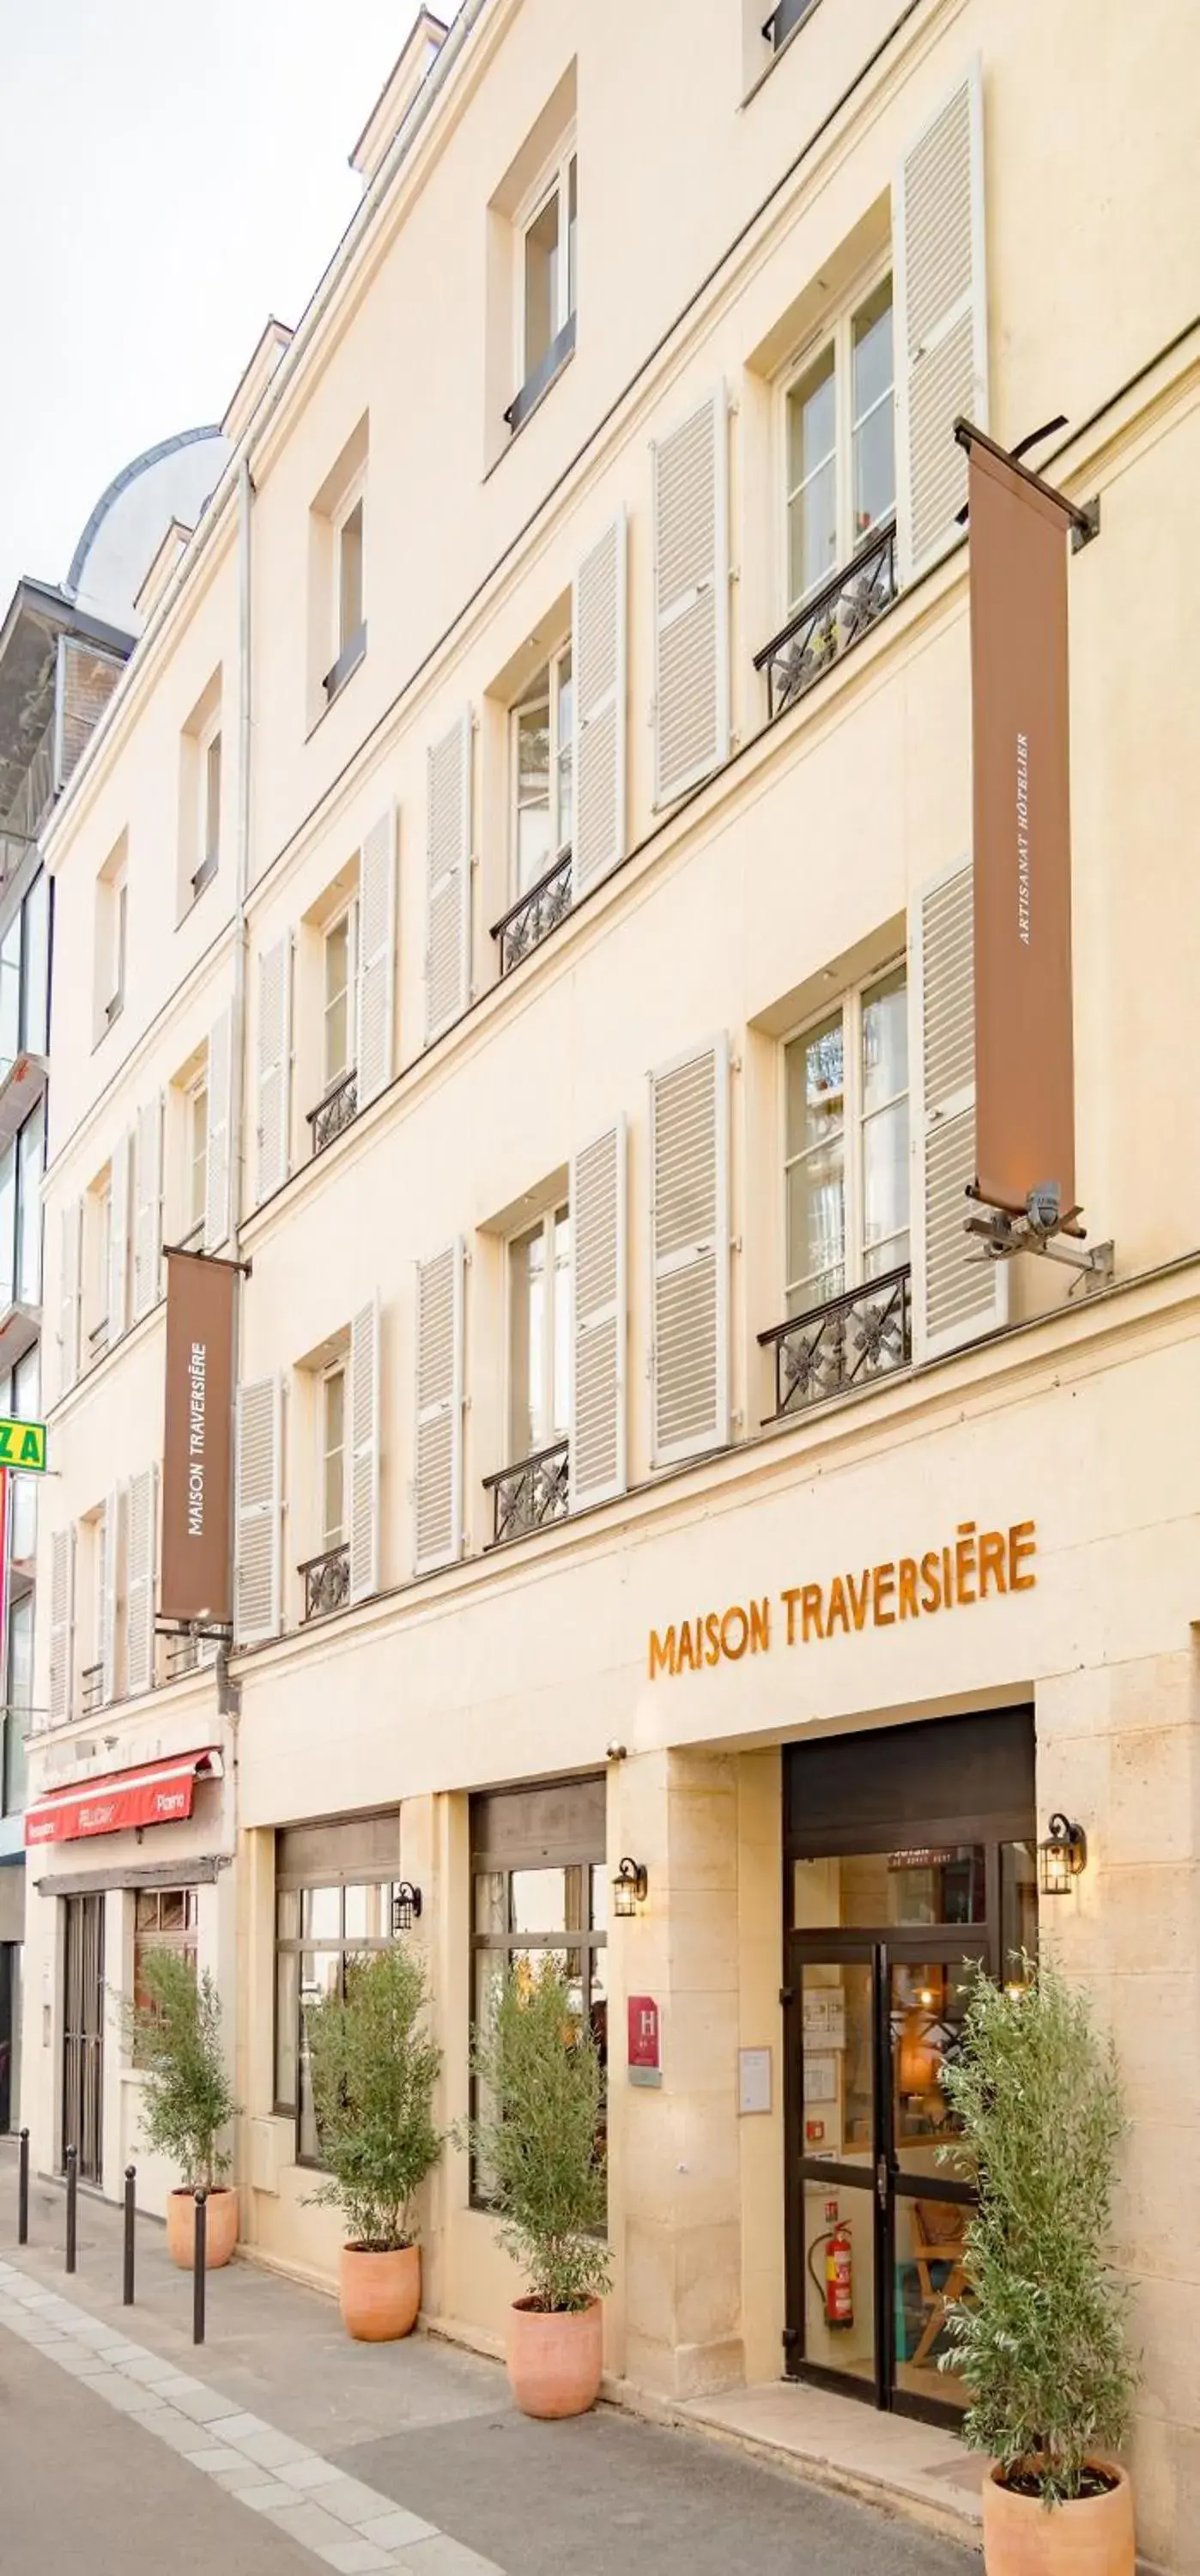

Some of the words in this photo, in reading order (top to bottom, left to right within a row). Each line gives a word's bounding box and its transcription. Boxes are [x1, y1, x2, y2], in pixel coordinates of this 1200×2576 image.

[1018, 834, 1030, 945] ARTISANAT
[188, 1463, 203, 1536] MAISON
[648, 1597, 771, 1680] MAISON
[641, 2010, 655, 2036] H
